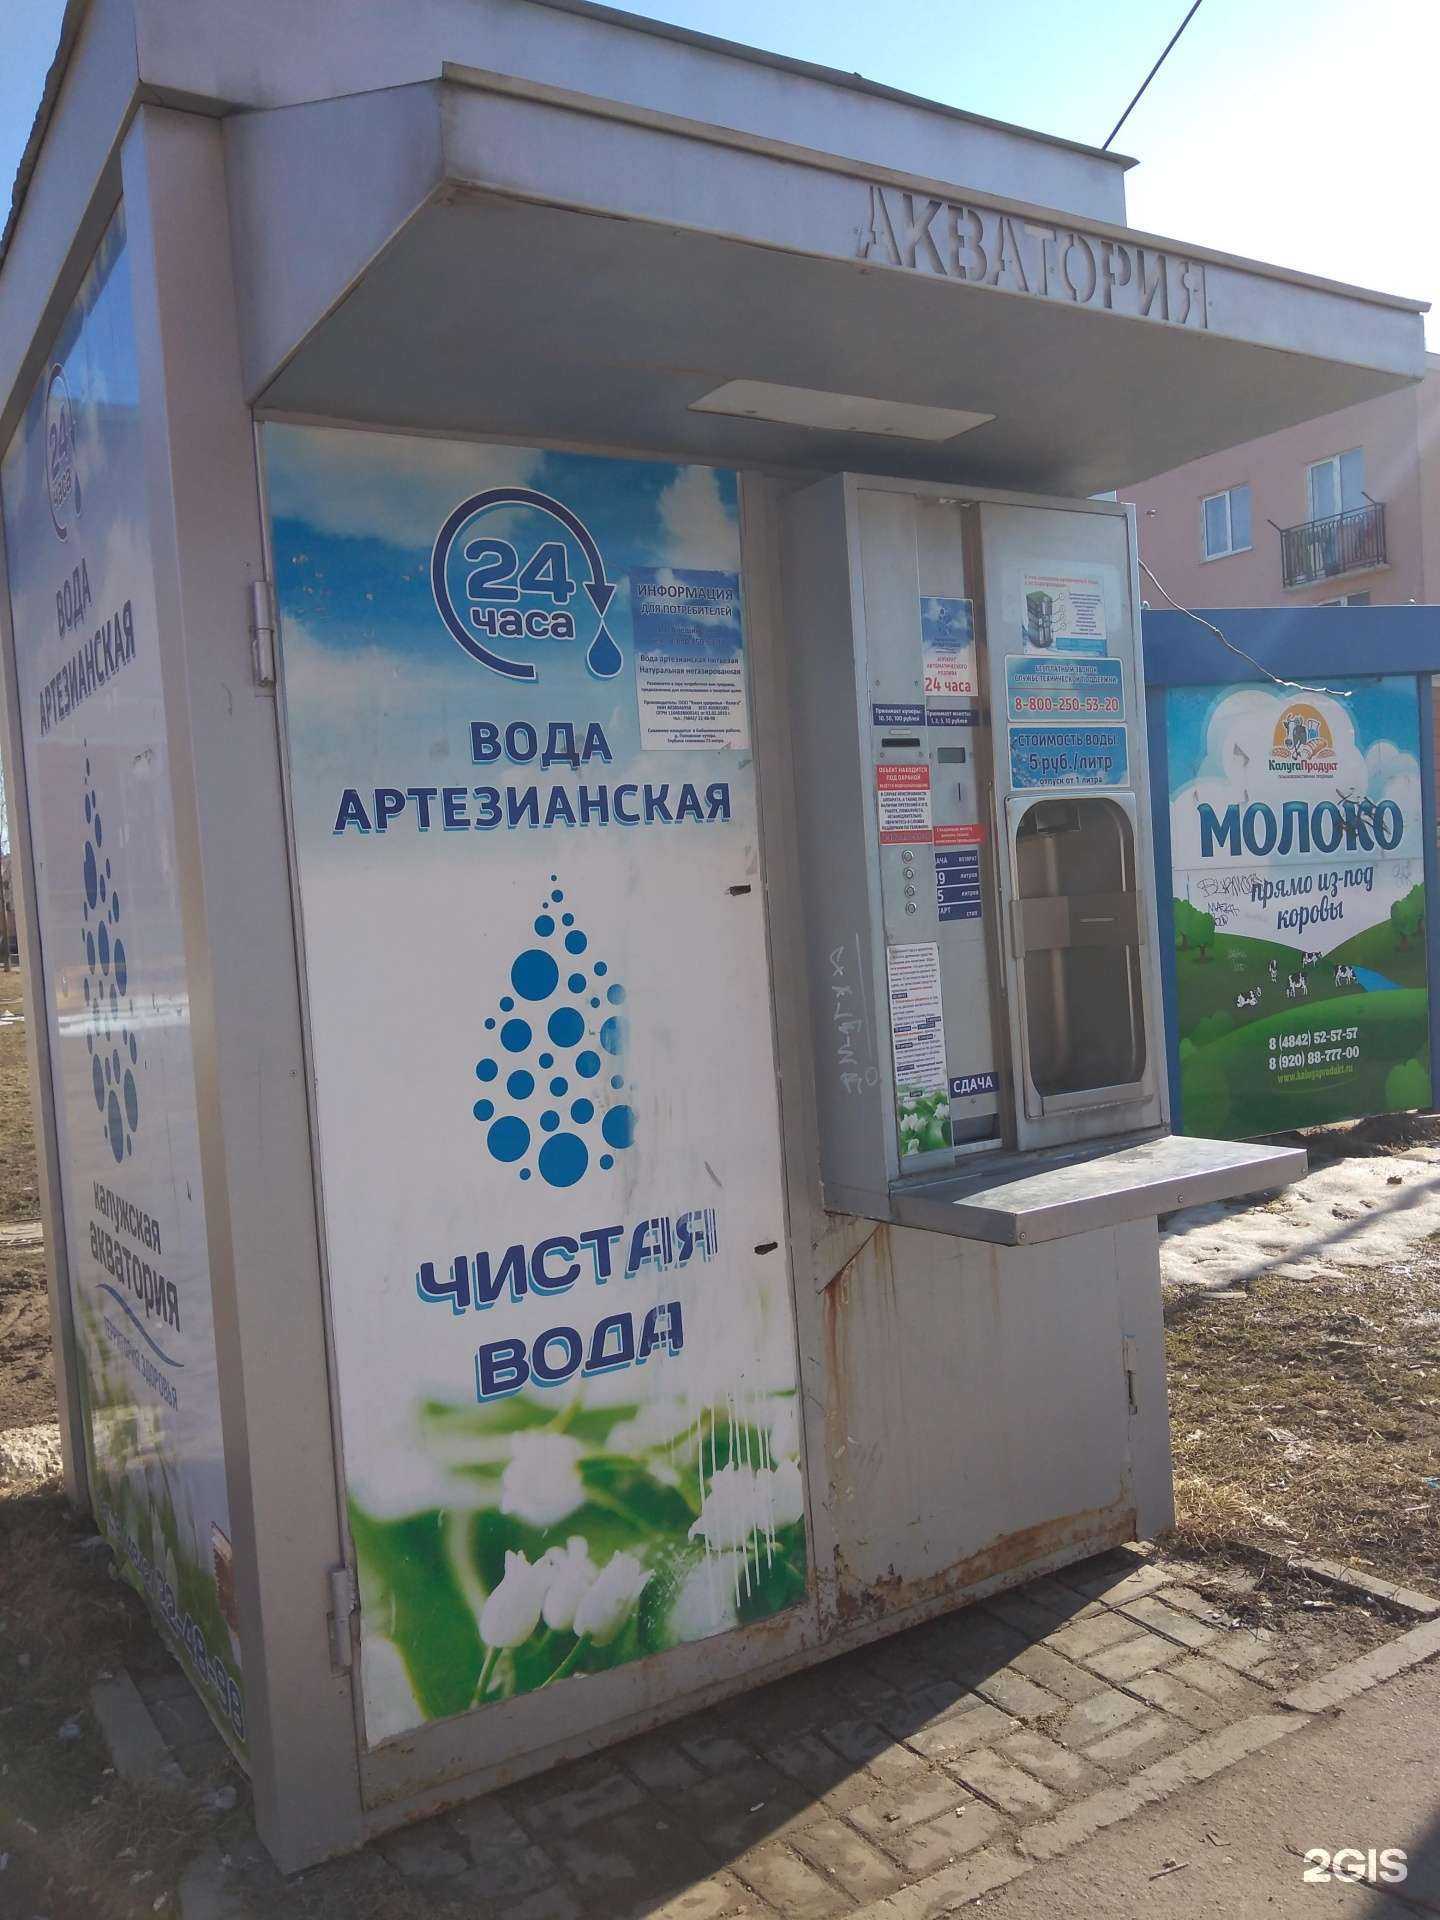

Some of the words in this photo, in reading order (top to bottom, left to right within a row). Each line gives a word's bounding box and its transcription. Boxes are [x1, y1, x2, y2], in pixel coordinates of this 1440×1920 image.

[857, 186, 1209, 329] АКВАТОРИЯ
[463, 537, 575, 604] 24
[56, 557, 93, 640] ВОДА
[638, 584, 734, 600] ИНФОРМАЦИЯ
[469, 607, 576, 639] часа
[641, 603, 660, 614] ДЛЯ
[663, 604, 733, 616] ПОТРЕБИТЕЛЕЙ
[39, 599, 137, 736] АРТЕЗИАНСКАЯ
[640, 654, 658, 663] Вода
[640, 666, 685, 676] Натуральная
[925, 677, 941, 692] 24
[944, 681, 972, 692] часа
[1015, 696, 1119, 711] 8-800-250-53-20
[469, 720, 613, 769] ВОДА
[1018, 734, 1083, 747] СТОИМОСТЬ
[1029, 754, 1039, 770] 5
[1041, 753, 1113, 774] руб./литр
[1268, 760, 1338, 773] КалугаПродукт
[1040, 777, 1064, 786] отпуск
[333, 782, 731, 835] АРТЕЗИАНСКАЯ
[1197, 800, 1404, 857] МОЛОКО
[937, 890, 944, 902] 5
[1251, 873, 1313, 908] прямо
[1318, 865, 1374, 899] из-под
[1277, 896, 1344, 934] коровы
[1269, 1038, 1276, 1050] 8
[1279, 1030, 1311, 1051] (4842)
[1314, 1027, 1358, 1044] 52-57-57
[1269, 1057, 1277, 1070] 8
[1279, 1051, 1305, 1071] (920)
[1307, 1045, 1360, 1064] 88-777-00
[953, 1077, 994, 1095] СДАЧА
[93, 1181, 162, 1255] калужская
[89, 1220, 181, 1333] акватория
[416, 1208, 718, 1317] ЧИСТАЯ
[476, 1301, 684, 1402] ВОДА
